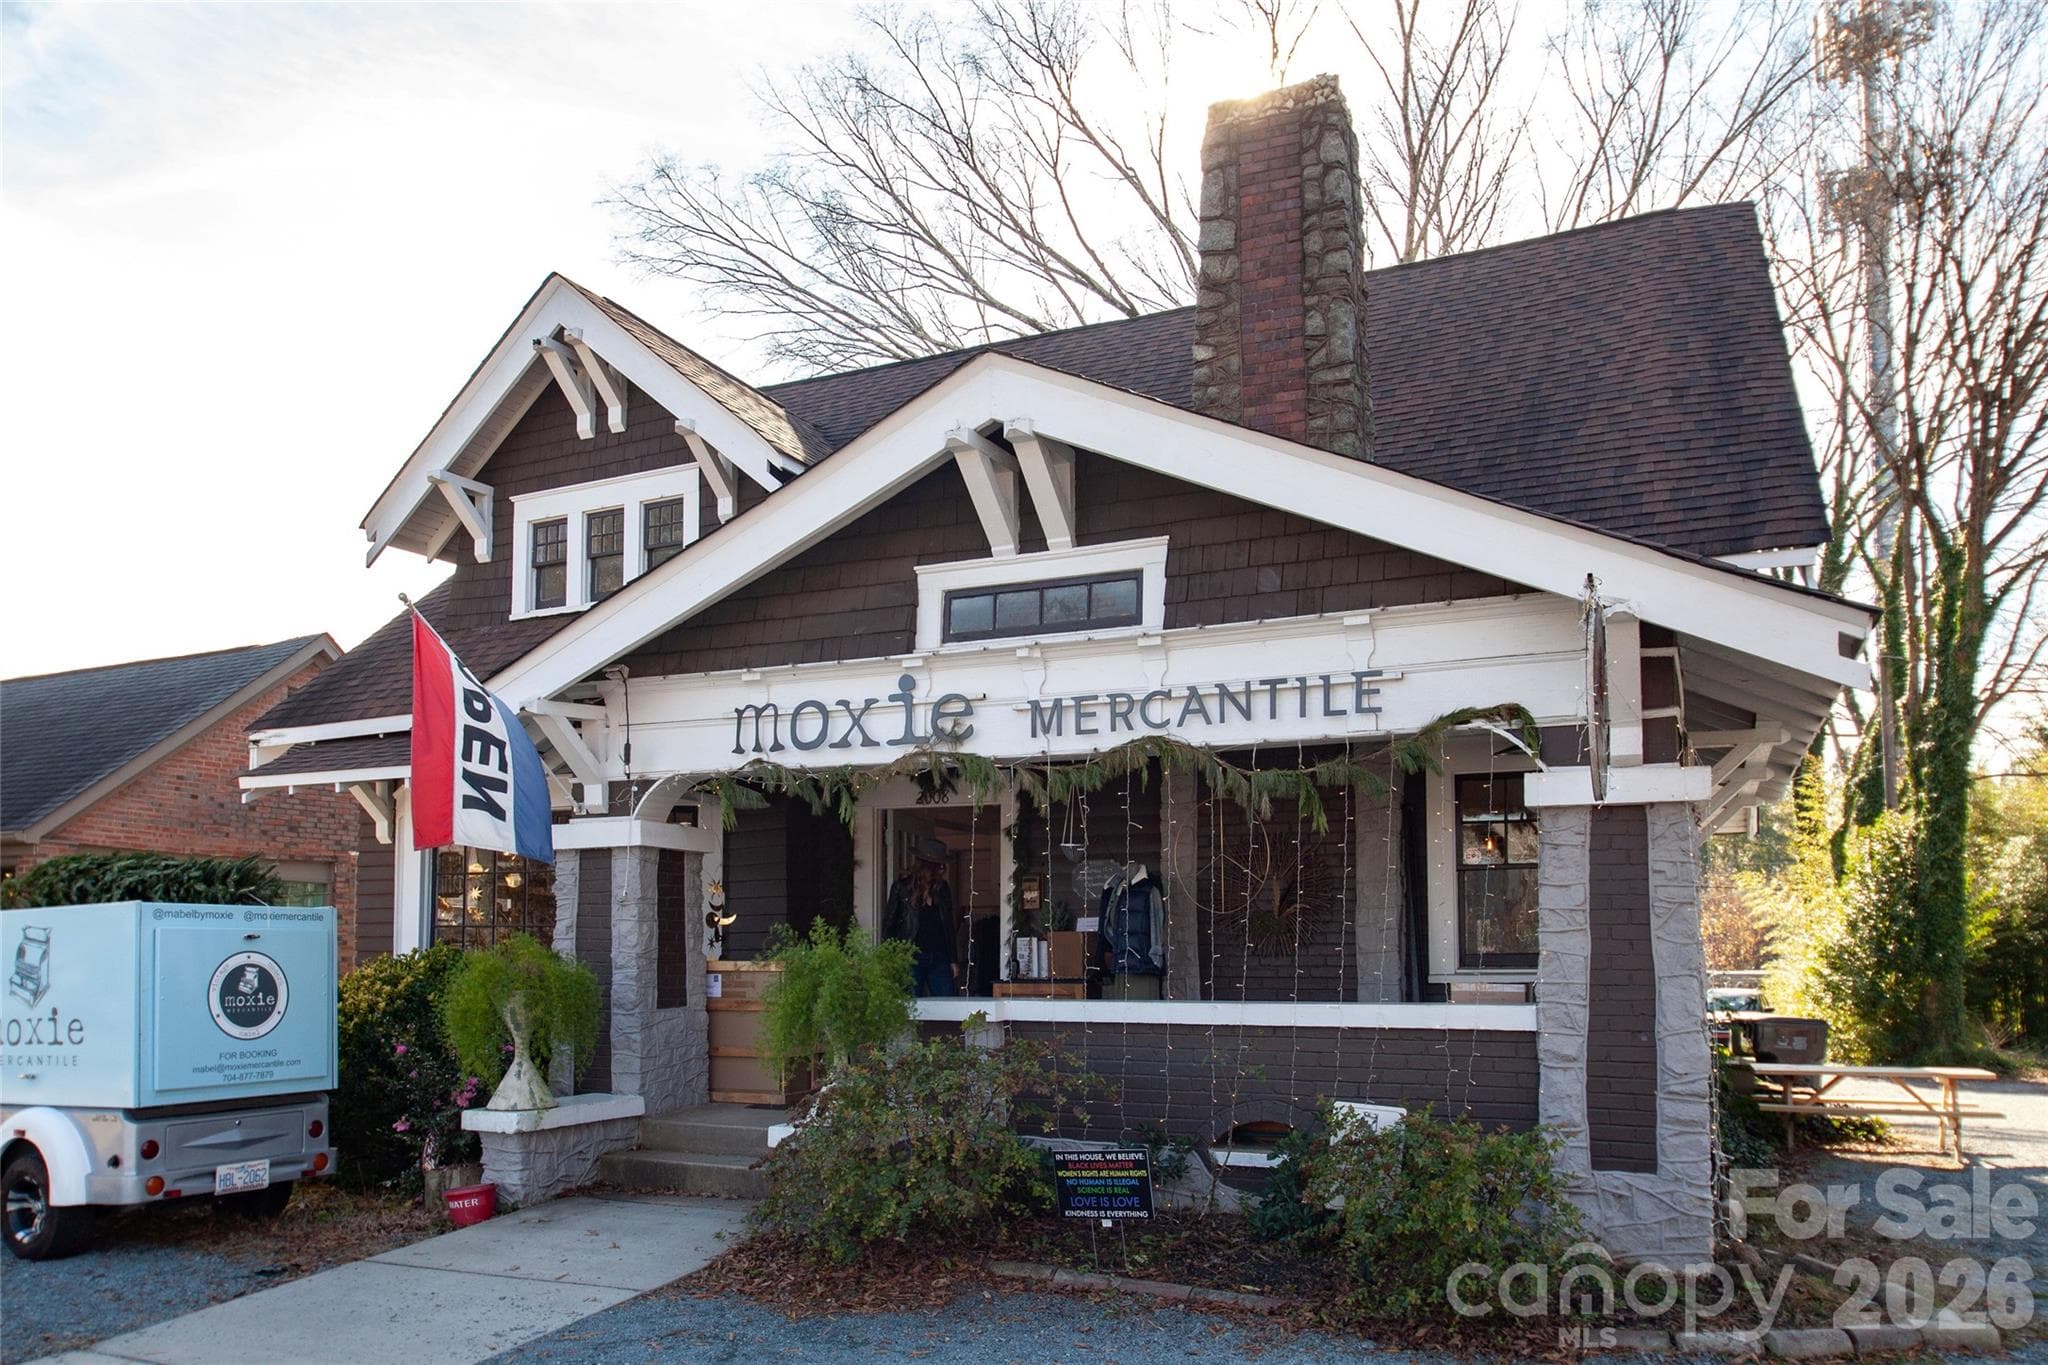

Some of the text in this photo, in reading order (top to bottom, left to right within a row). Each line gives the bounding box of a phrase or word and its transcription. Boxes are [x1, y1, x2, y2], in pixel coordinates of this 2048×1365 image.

[733, 670, 1384, 755] moxie MERCANTILE
[152, 908, 234, 921] @mabelbymoxie
[224, 992, 276, 1007] moxie
[0, 1007, 84, 1046] oxie
[219, 1049, 277, 1060] FOR BOOKING
[1070, 1196, 1140, 1207] LOVE IS LOVE
[1065, 1210, 1098, 1218] KINDNESS
[1107, 1210, 1149, 1218] EVERYTHING
